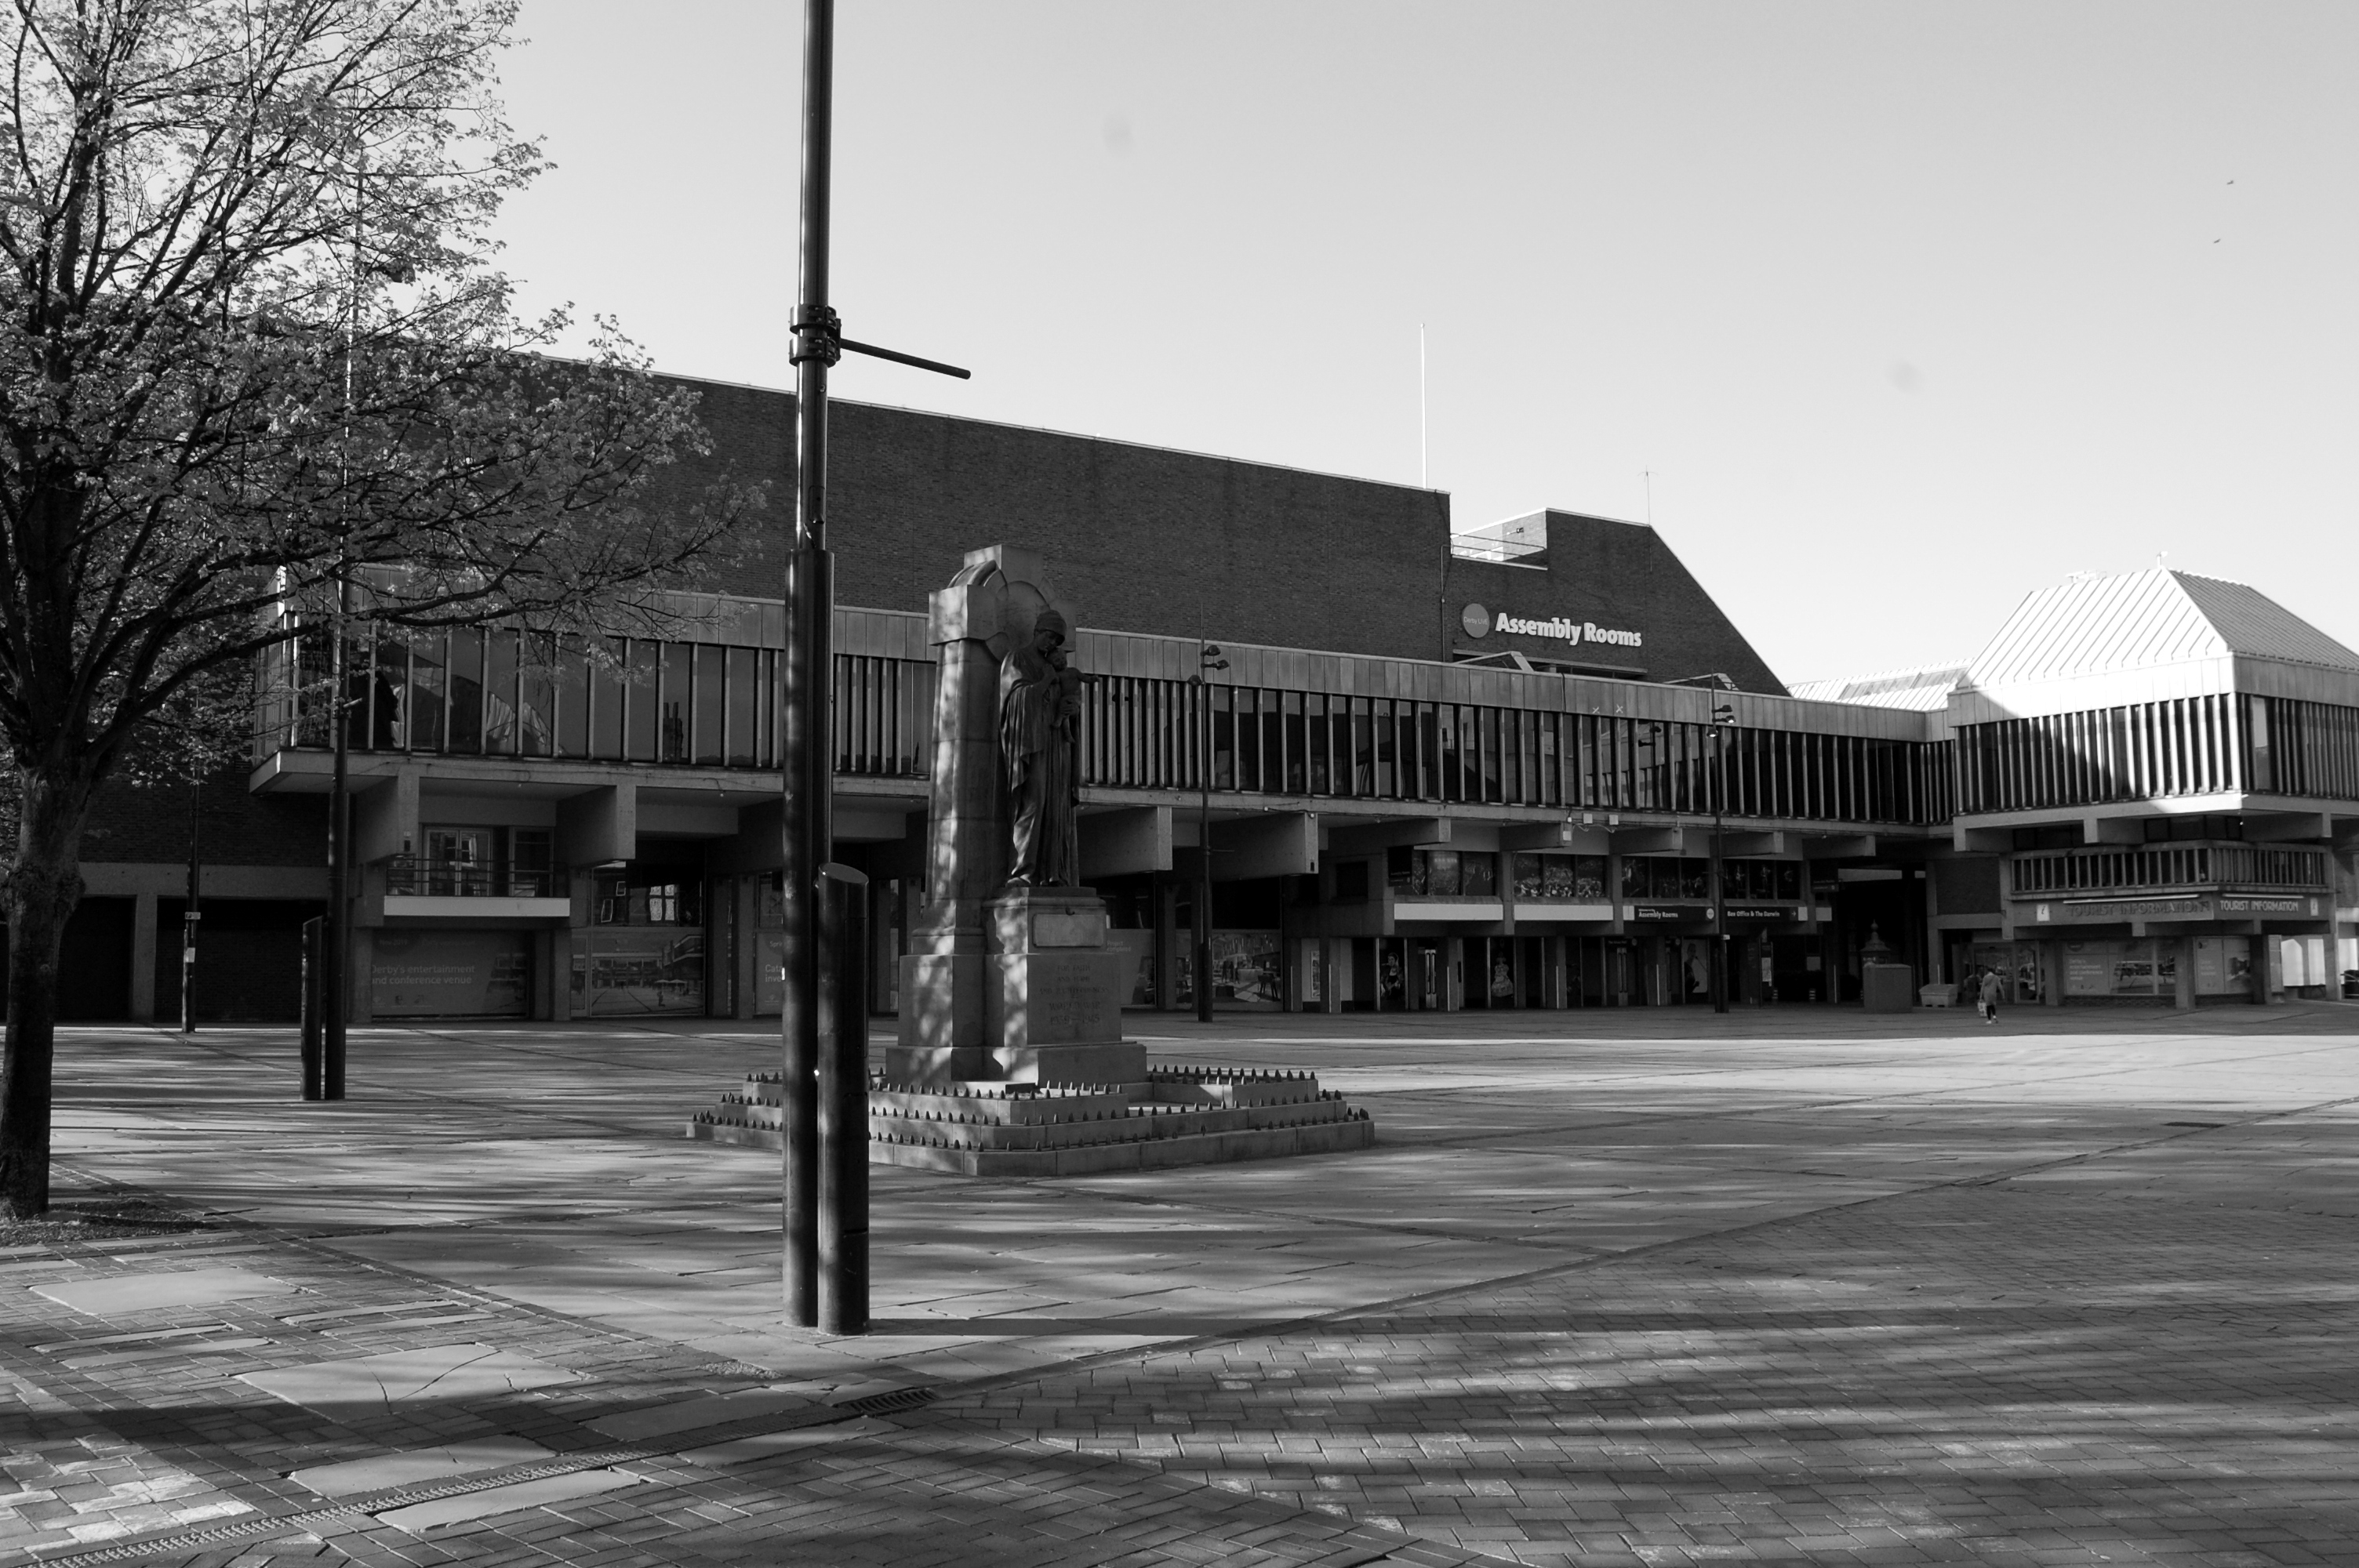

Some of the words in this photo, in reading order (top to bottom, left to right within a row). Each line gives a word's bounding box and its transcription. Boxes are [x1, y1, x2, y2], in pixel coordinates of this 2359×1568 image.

[1495, 612, 1582, 646] Assembly
[1583, 622, 1642, 646] Rooms
[2069, 903, 2116, 917] TOURIST
[2219, 900, 2249, 911] TOURIST
[2250, 900, 2299, 912] INFORMATION
[407, 965, 475, 974] entertainment
[389, 975, 442, 985] conference
